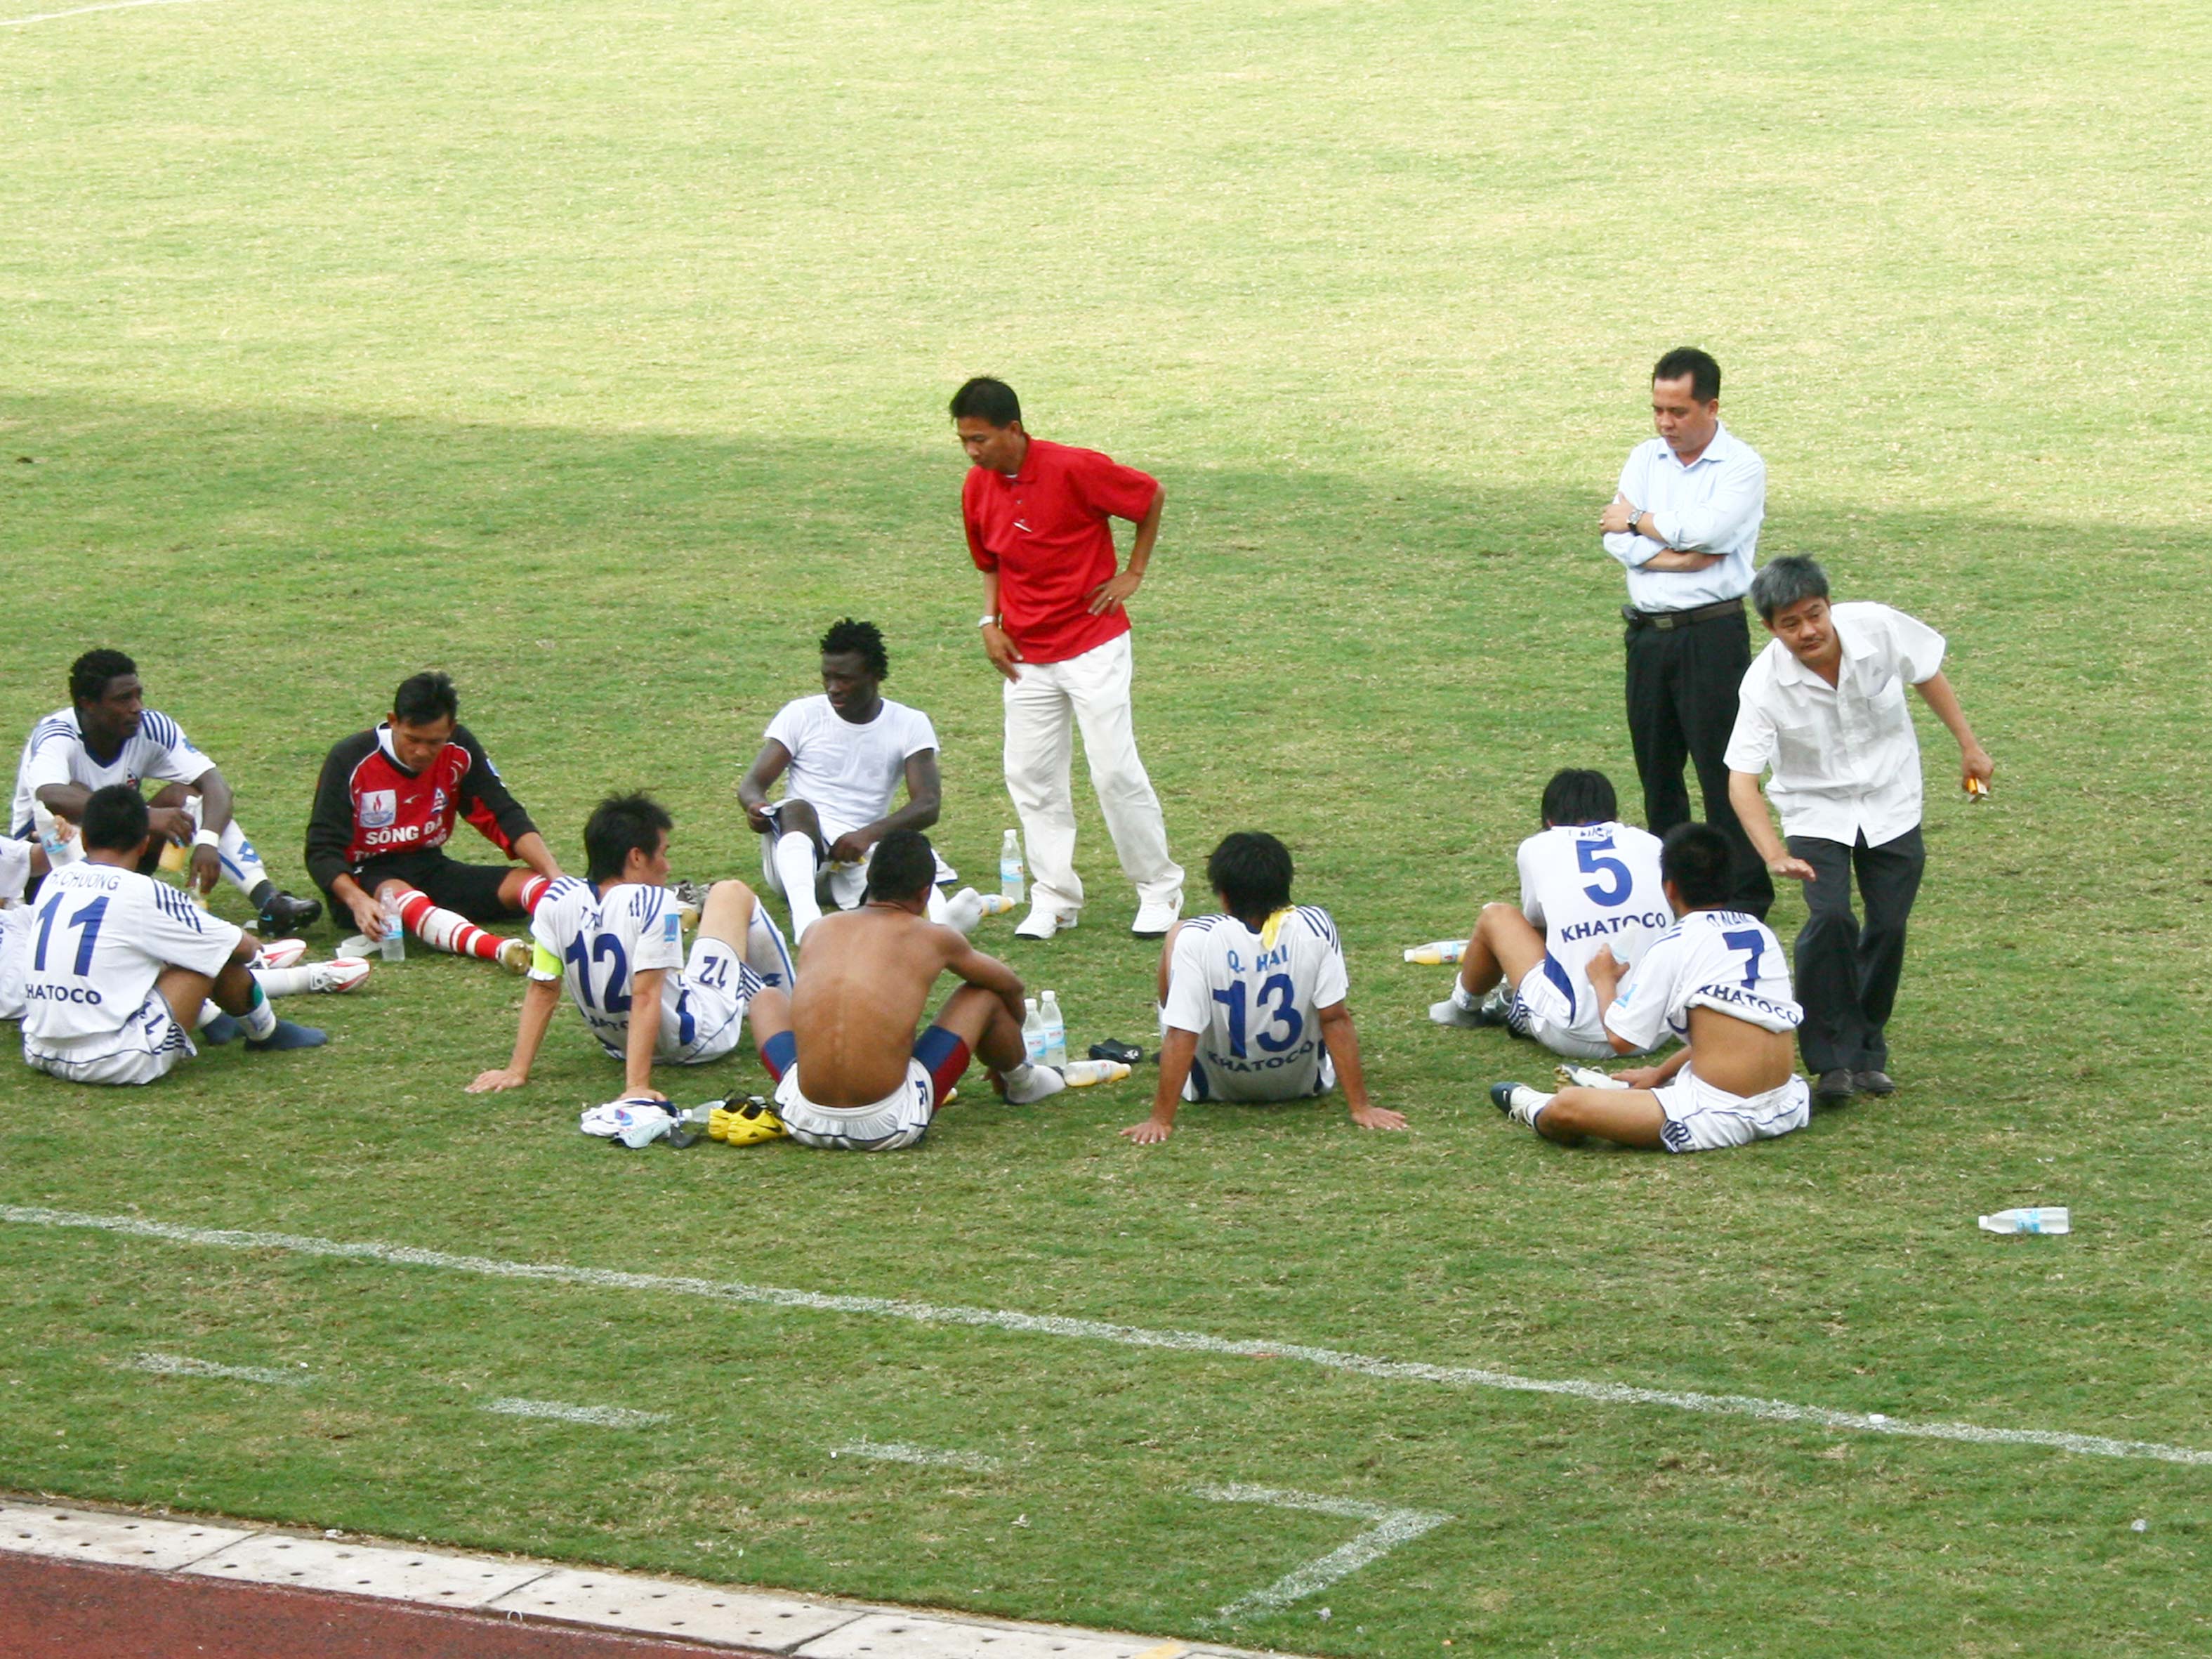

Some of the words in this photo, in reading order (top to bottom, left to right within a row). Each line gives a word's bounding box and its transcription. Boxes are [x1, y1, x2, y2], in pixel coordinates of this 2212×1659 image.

[1576, 836, 1633, 907] 5
[34, 891, 110, 977] 11
[1561, 912, 1666, 943] KHATOCO
[1722, 929, 1765, 990] 7
[565, 931, 631, 1014] 12
[1696, 984, 1800, 1025] KHATOCO
[1213, 973, 1303, 1060] 13
